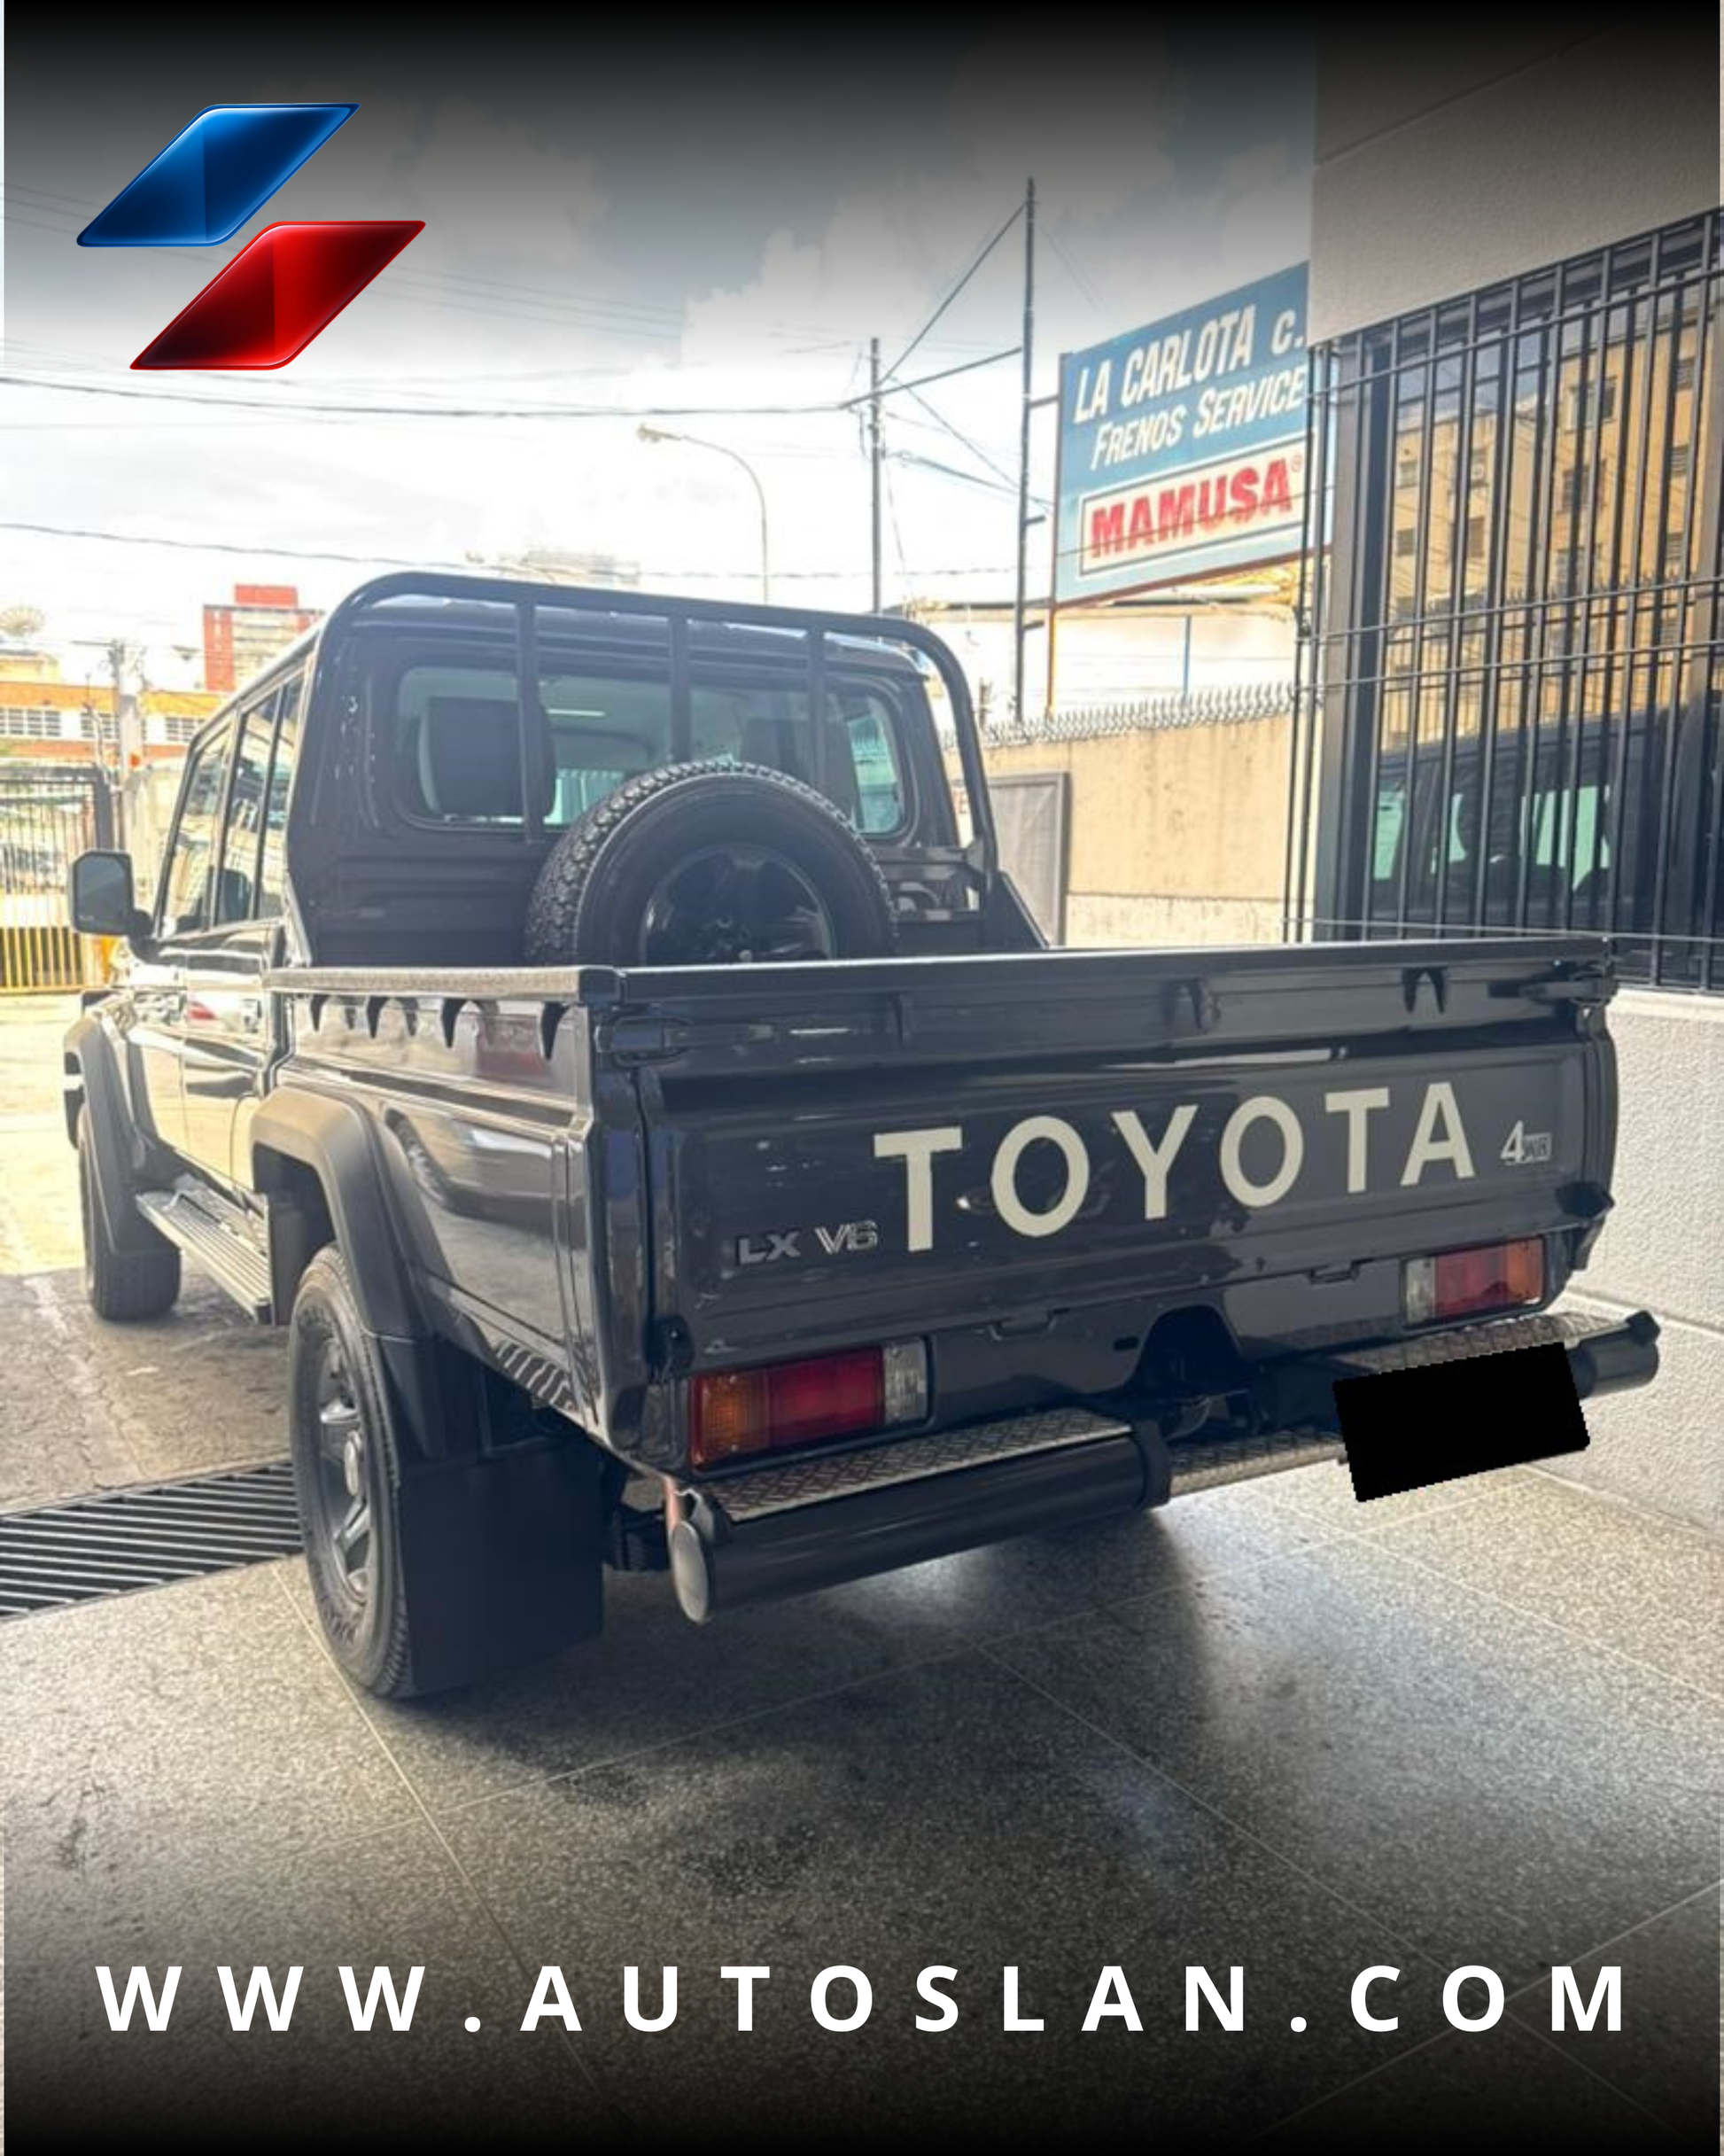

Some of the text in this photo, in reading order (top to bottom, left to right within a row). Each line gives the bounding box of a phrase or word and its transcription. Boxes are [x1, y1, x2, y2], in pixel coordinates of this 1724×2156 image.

[1073, 358, 1113, 424] LA
[1121, 304, 1257, 408] CARLOTA
[1091, 365, 1307, 471] FRENOS SERVICE
[1091, 457, 1294, 558] MAMUSA
[874, 1082, 1475, 1252] TOYOTA
[738, 1219, 878, 1265] LX V6
